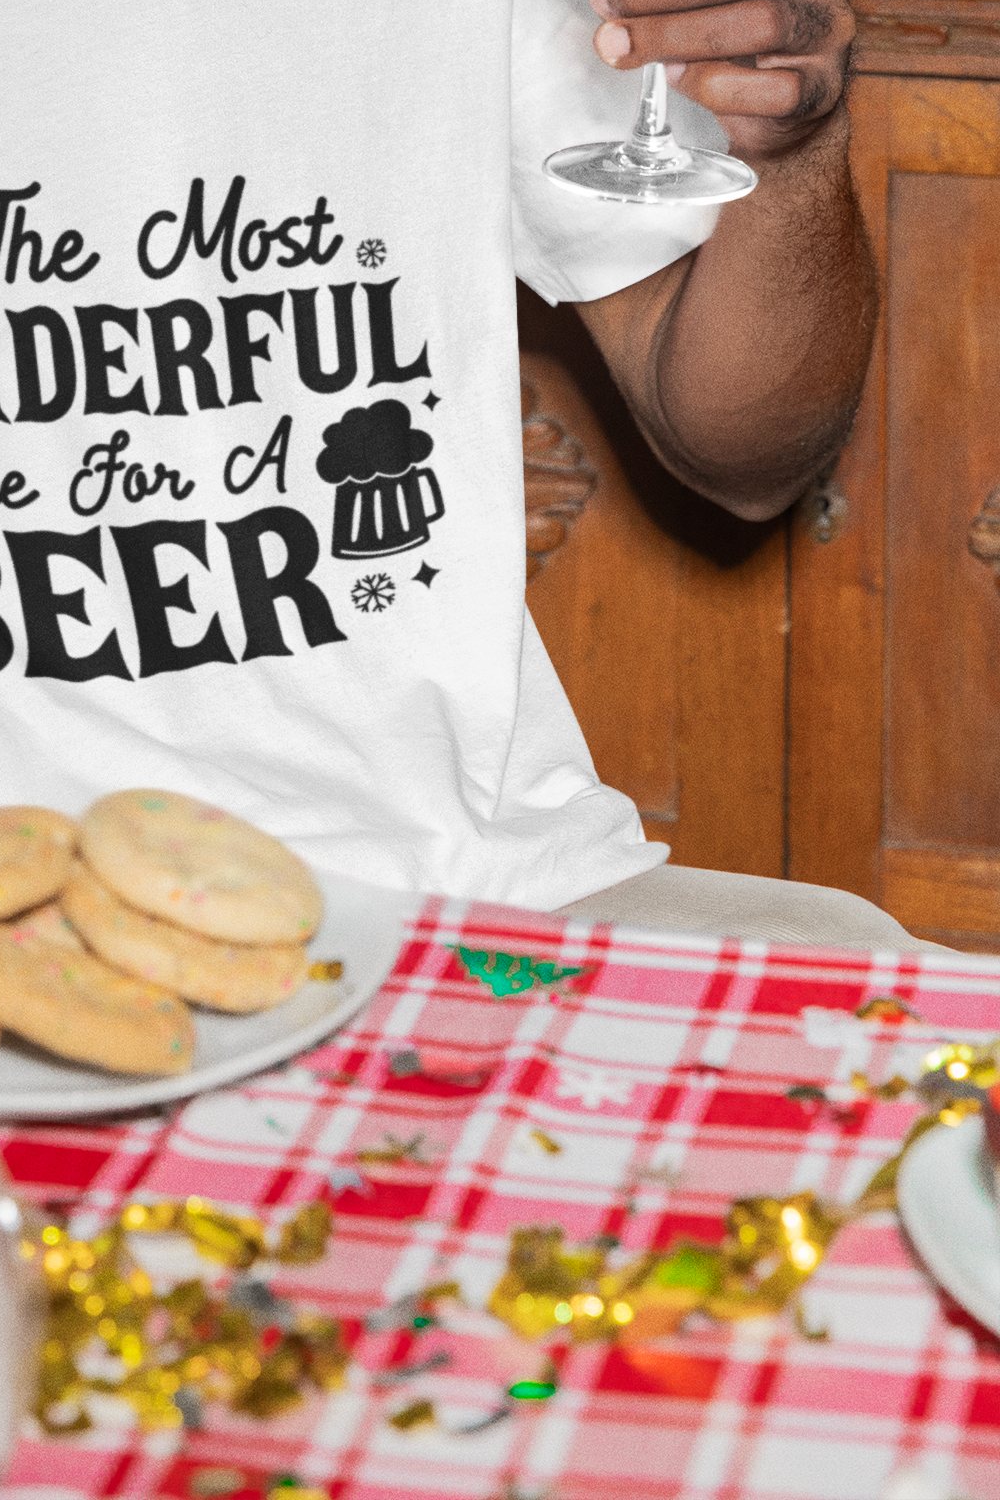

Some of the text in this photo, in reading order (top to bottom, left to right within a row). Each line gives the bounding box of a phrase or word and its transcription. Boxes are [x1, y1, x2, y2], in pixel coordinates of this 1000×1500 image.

[137, 175, 344, 284] Most
[69, 429, 195, 517] For
[223, 414, 293, 495] A
